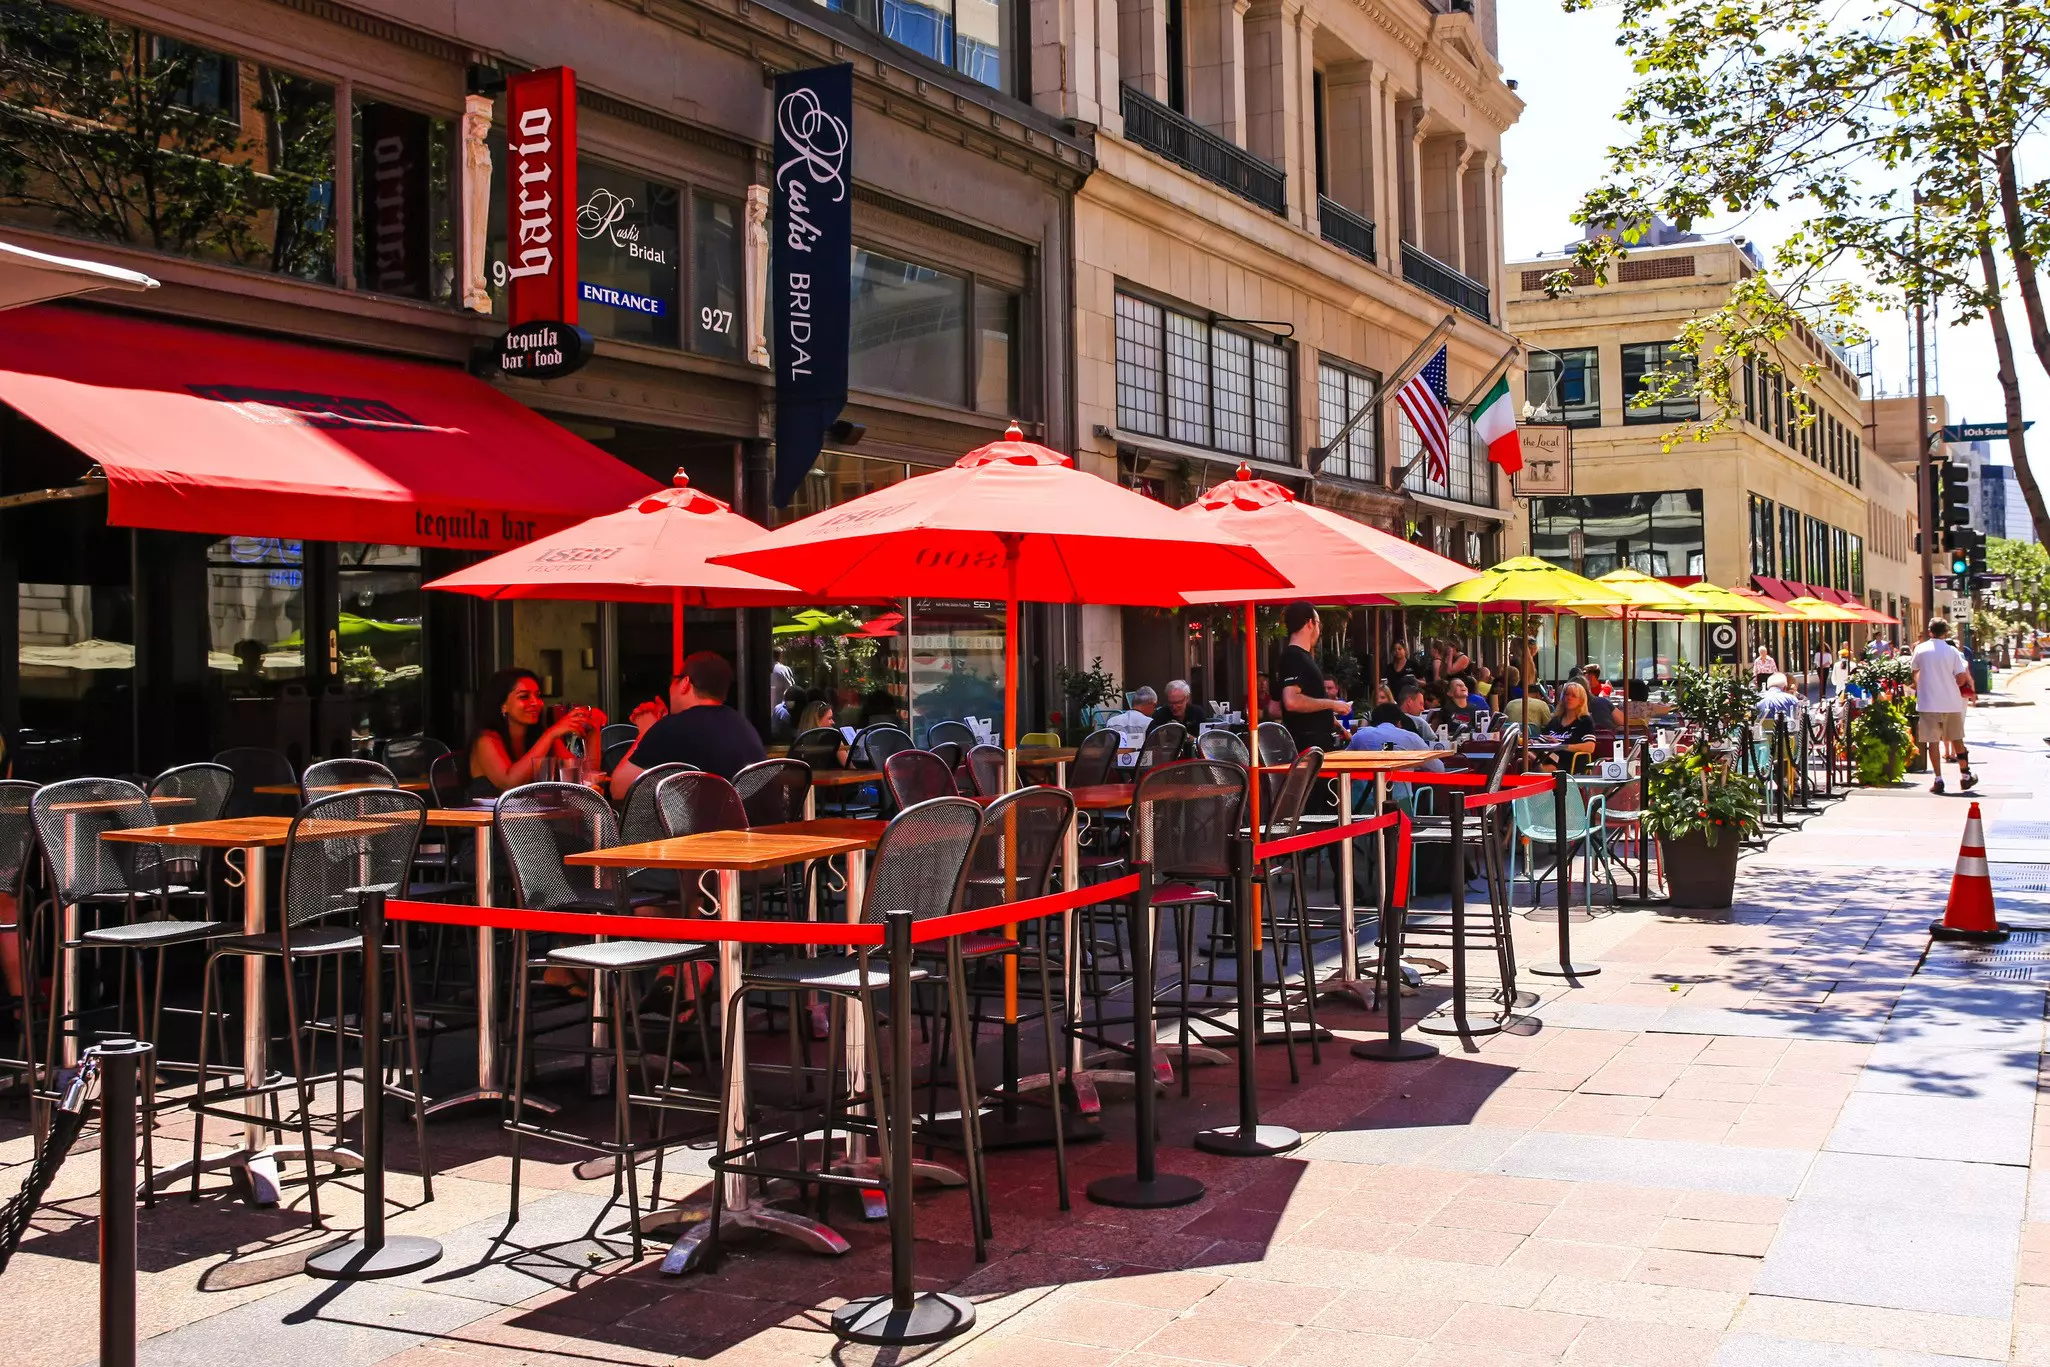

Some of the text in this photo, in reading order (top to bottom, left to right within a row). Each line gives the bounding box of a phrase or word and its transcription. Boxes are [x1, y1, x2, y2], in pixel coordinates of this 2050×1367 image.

[507, 107, 554, 282] barrio
[777, 87, 849, 382] Rush's BRIDAL
[629, 242, 666, 265] Bridal
[583, 284, 659, 314] ENTRANCE
[701, 306, 733, 334] 927
[506, 326, 559, 352] tequila
[501, 348, 563, 370] bar food
[1523, 433, 1560, 453] the Local
[1963, 427, 2008, 436] 10th Stree
[415, 508, 537, 542] tequila bar
